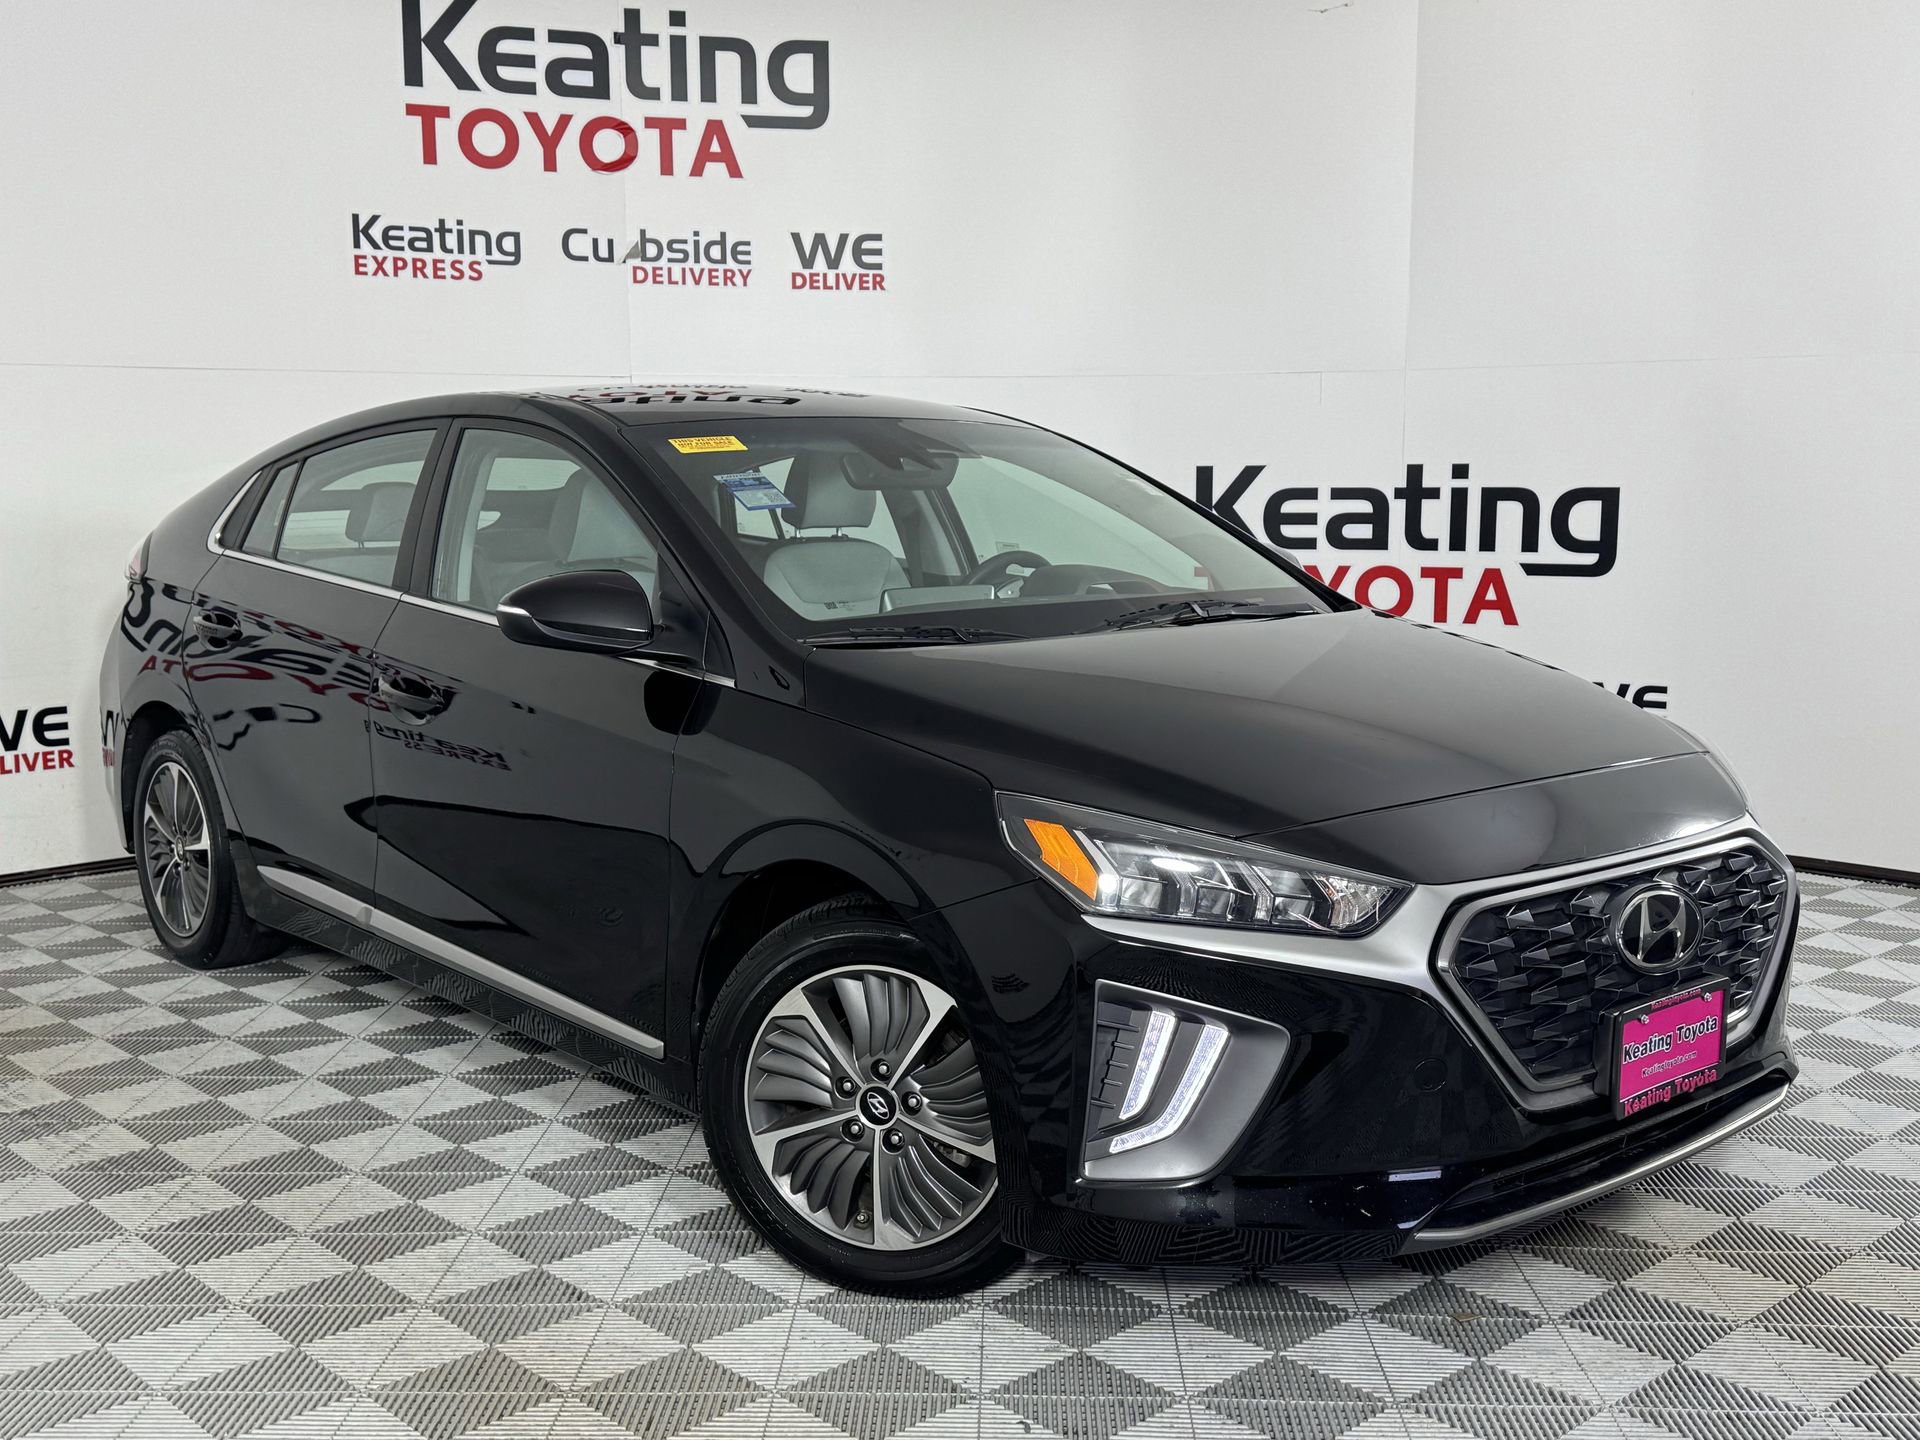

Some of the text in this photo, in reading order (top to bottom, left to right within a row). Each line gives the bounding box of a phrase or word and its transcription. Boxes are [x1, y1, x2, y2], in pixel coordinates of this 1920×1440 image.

[402, 0, 830, 129] Keating
[405, 103, 744, 179] TOYOTA
[352, 213, 521, 266] Keating
[561, 228, 752, 265] Cubside
[791, 232, 883, 270] WE
[353, 255, 483, 281] EXPRESS
[632, 266, 752, 287] DELIVERY
[791, 272, 886, 291] DELIVER
[1195, 463, 1621, 578] Keating
[1623, 1016, 1718, 1064] Keating Toyota
[1624, 1068, 1717, 1117] Keating Toyota
